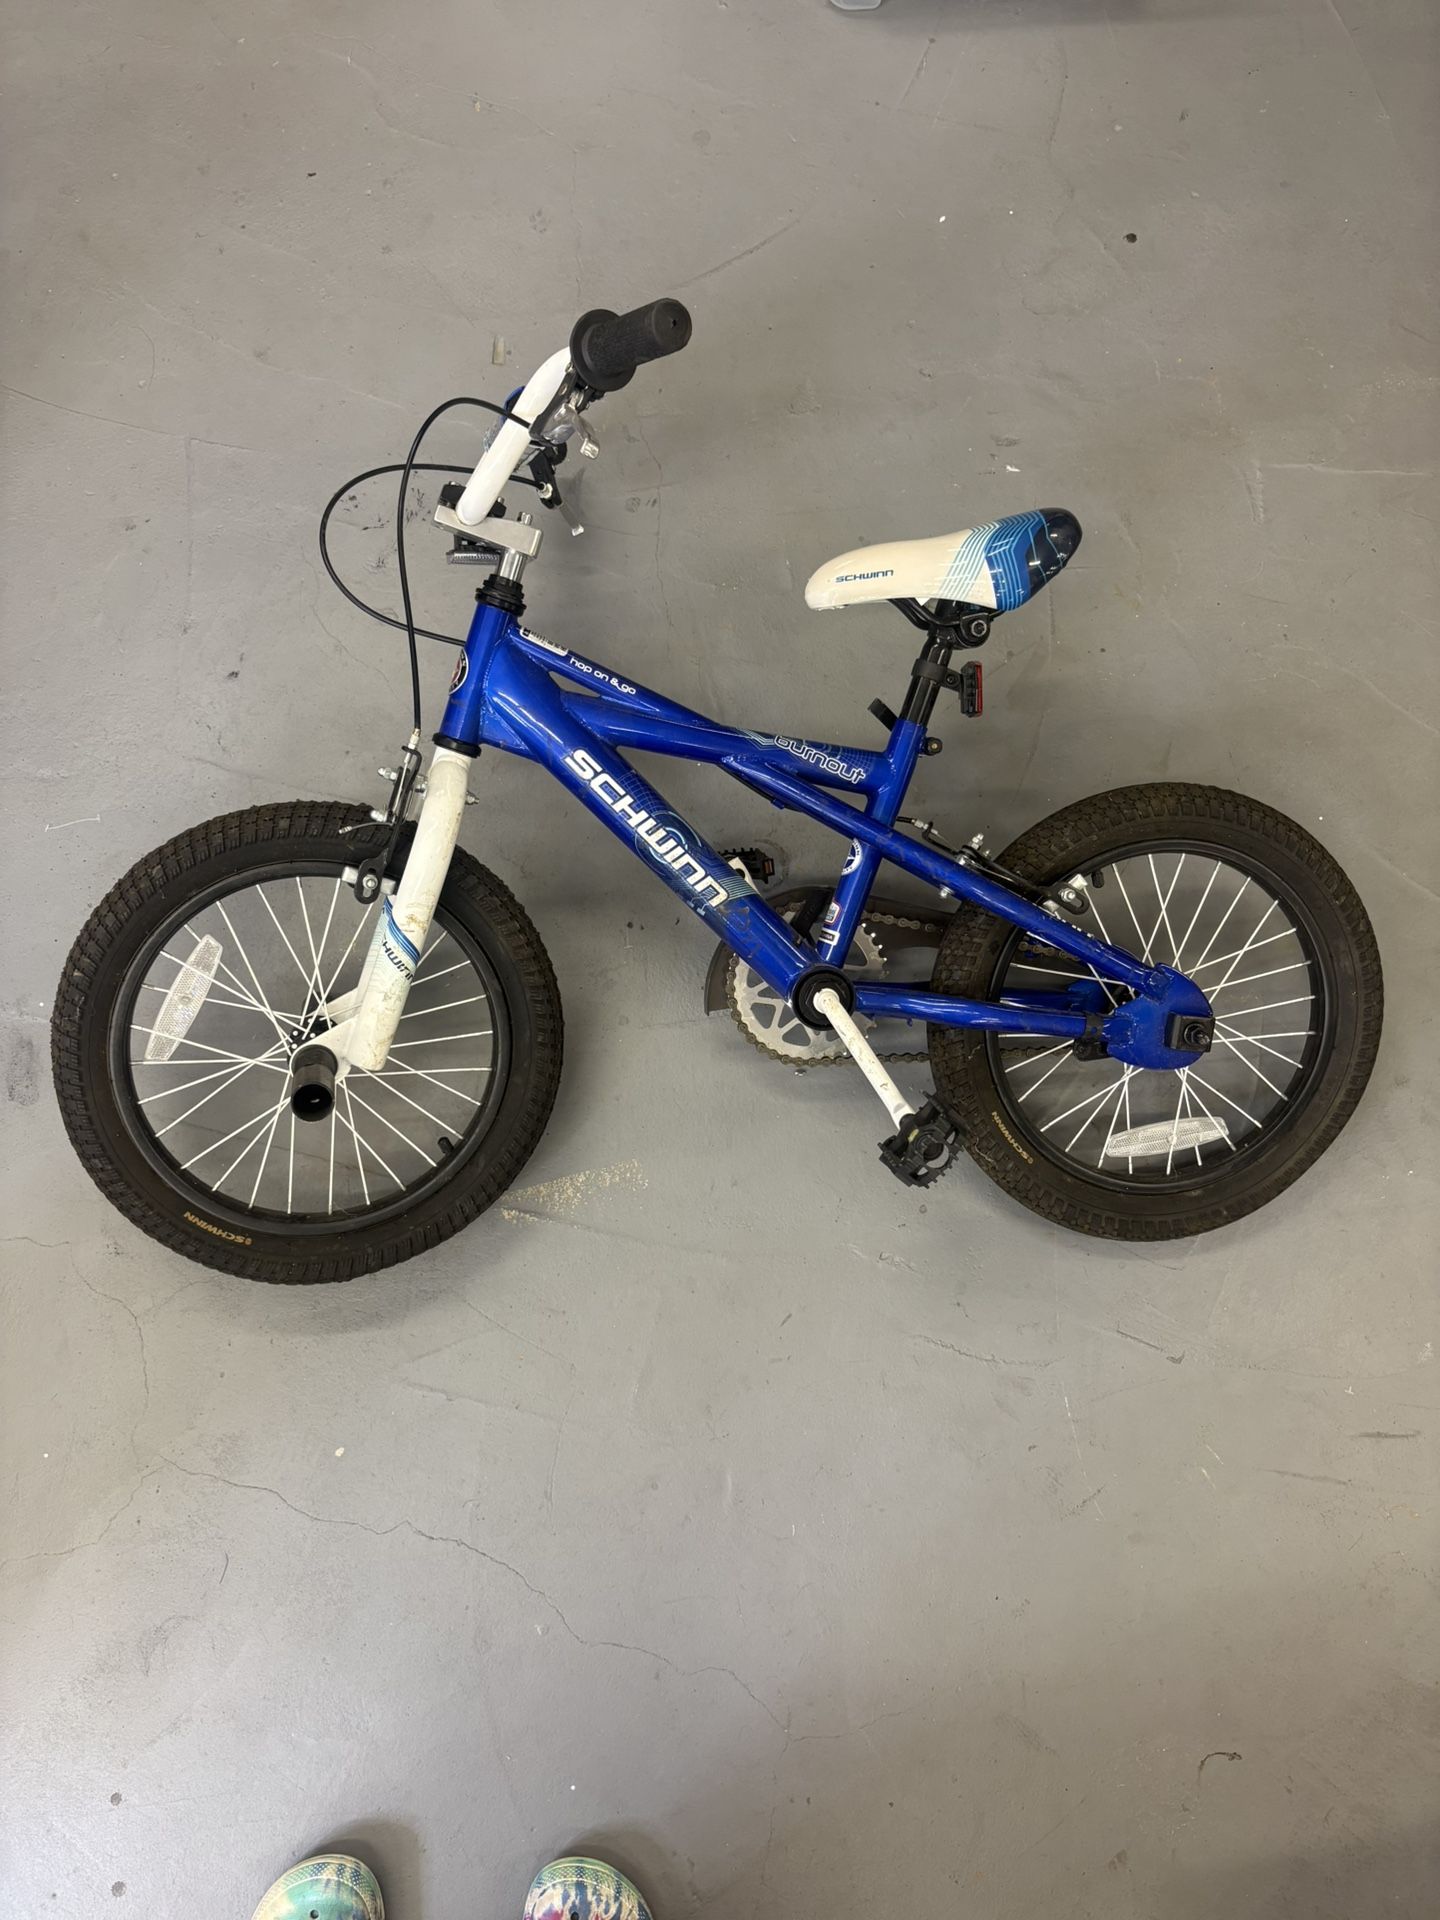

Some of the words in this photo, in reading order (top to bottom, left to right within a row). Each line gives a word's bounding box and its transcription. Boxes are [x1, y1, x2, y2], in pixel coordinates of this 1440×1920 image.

[835, 569, 894, 583] SCHWINN
[570, 656, 593, 674] hop
[594, 668, 609, 682] on
[774, 735, 866, 784] burnout
[563, 749, 730, 908] SCHWINN
[183, 1211, 246, 1243] SCHWINN
